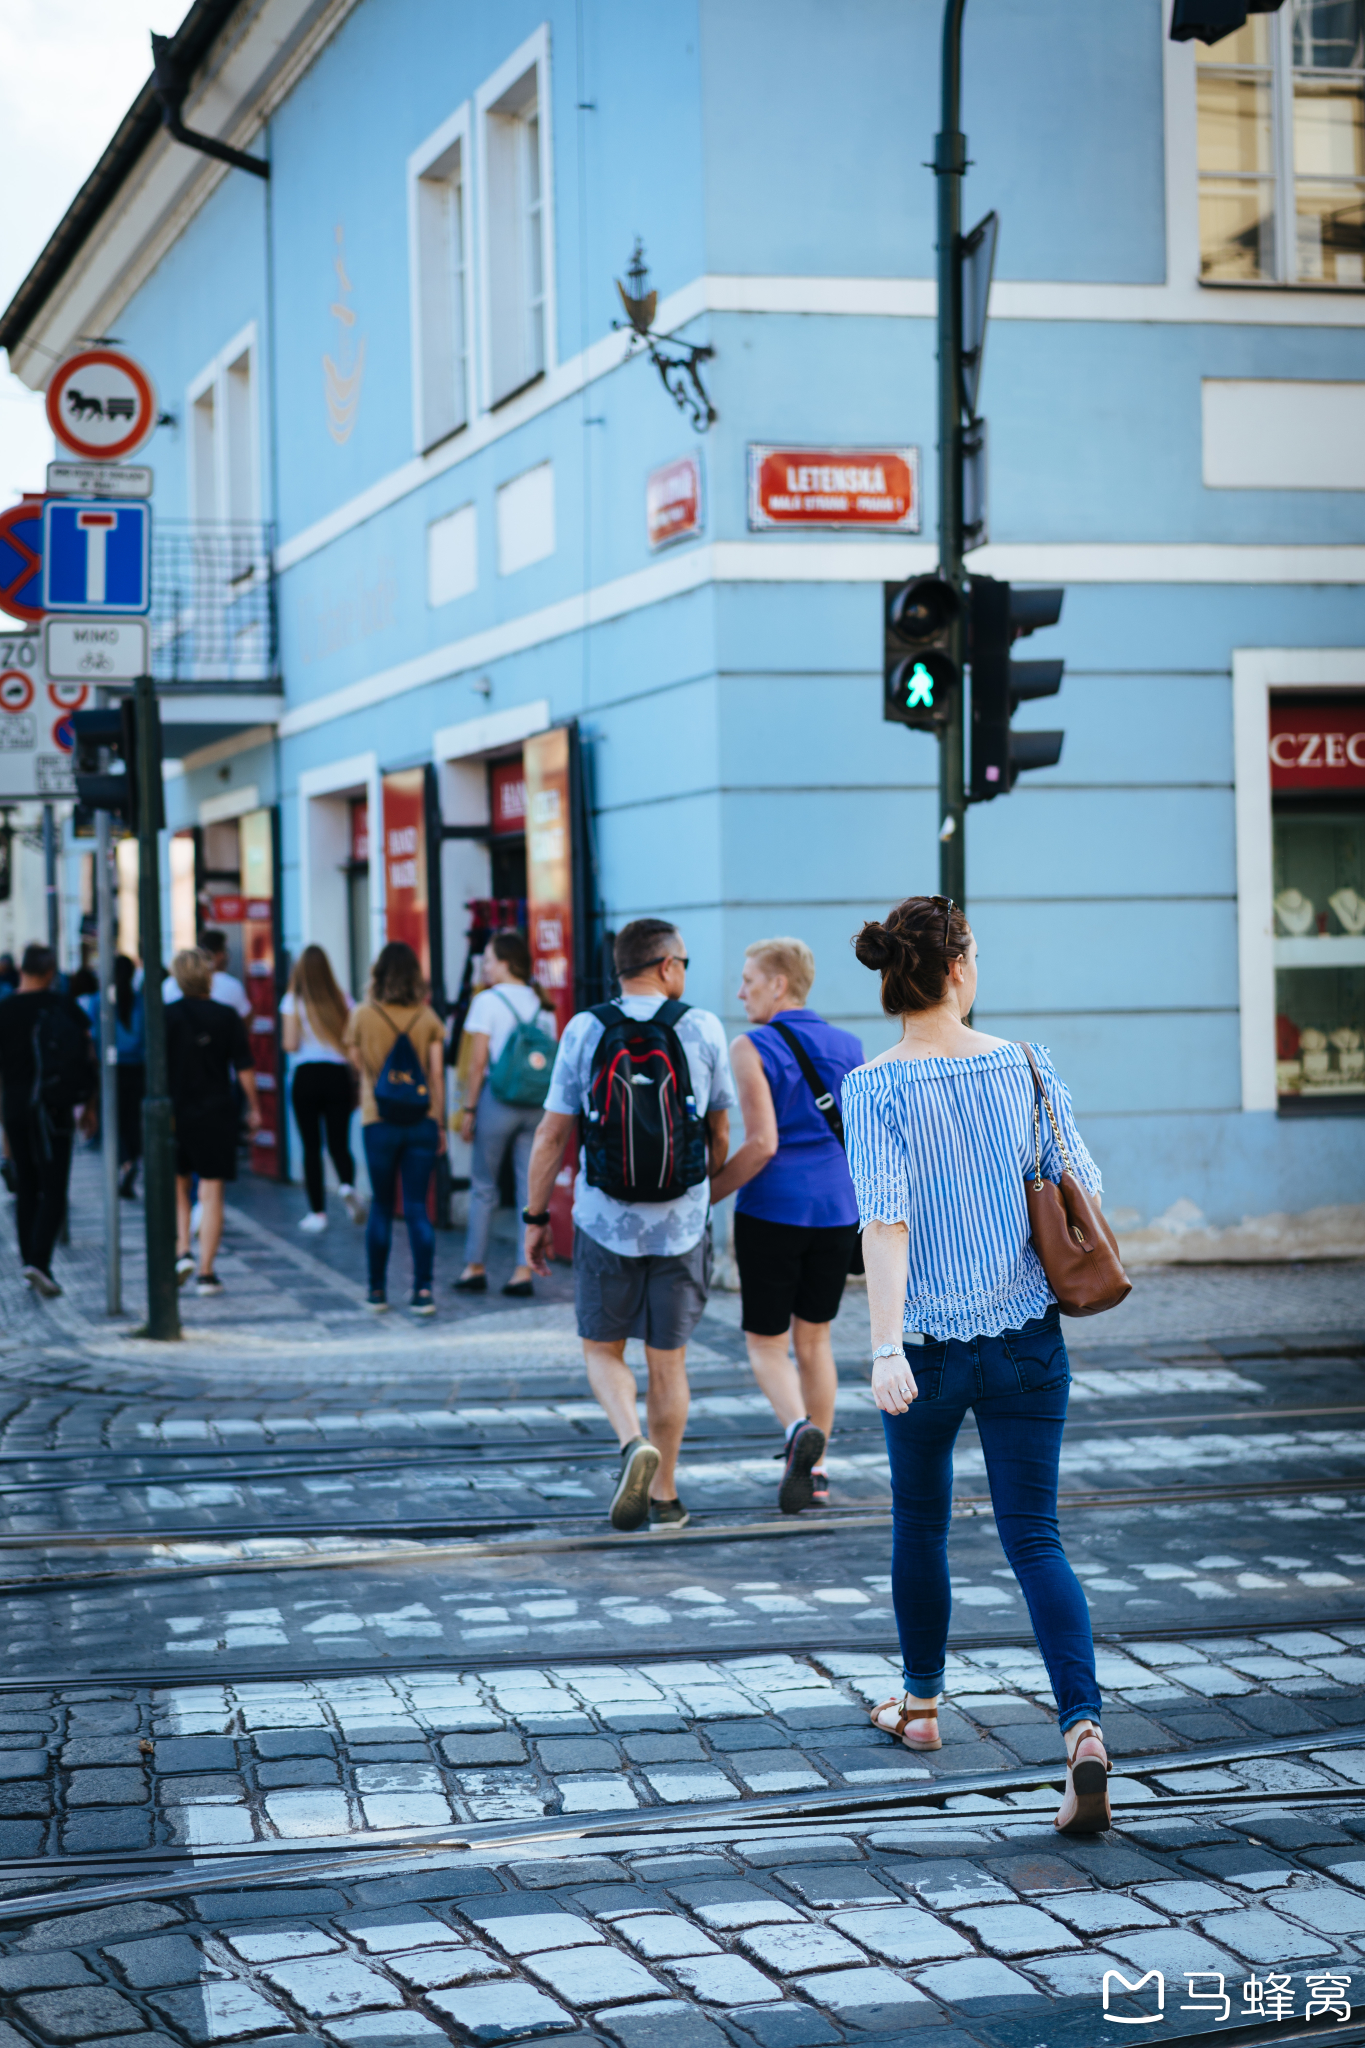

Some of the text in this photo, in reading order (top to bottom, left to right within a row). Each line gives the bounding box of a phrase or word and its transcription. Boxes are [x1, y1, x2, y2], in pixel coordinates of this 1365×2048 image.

[786, 464, 886, 494] LETENSKÁ
[73, 628, 120, 646] MIMO
[1269, 732, 1365, 768] CZEC
